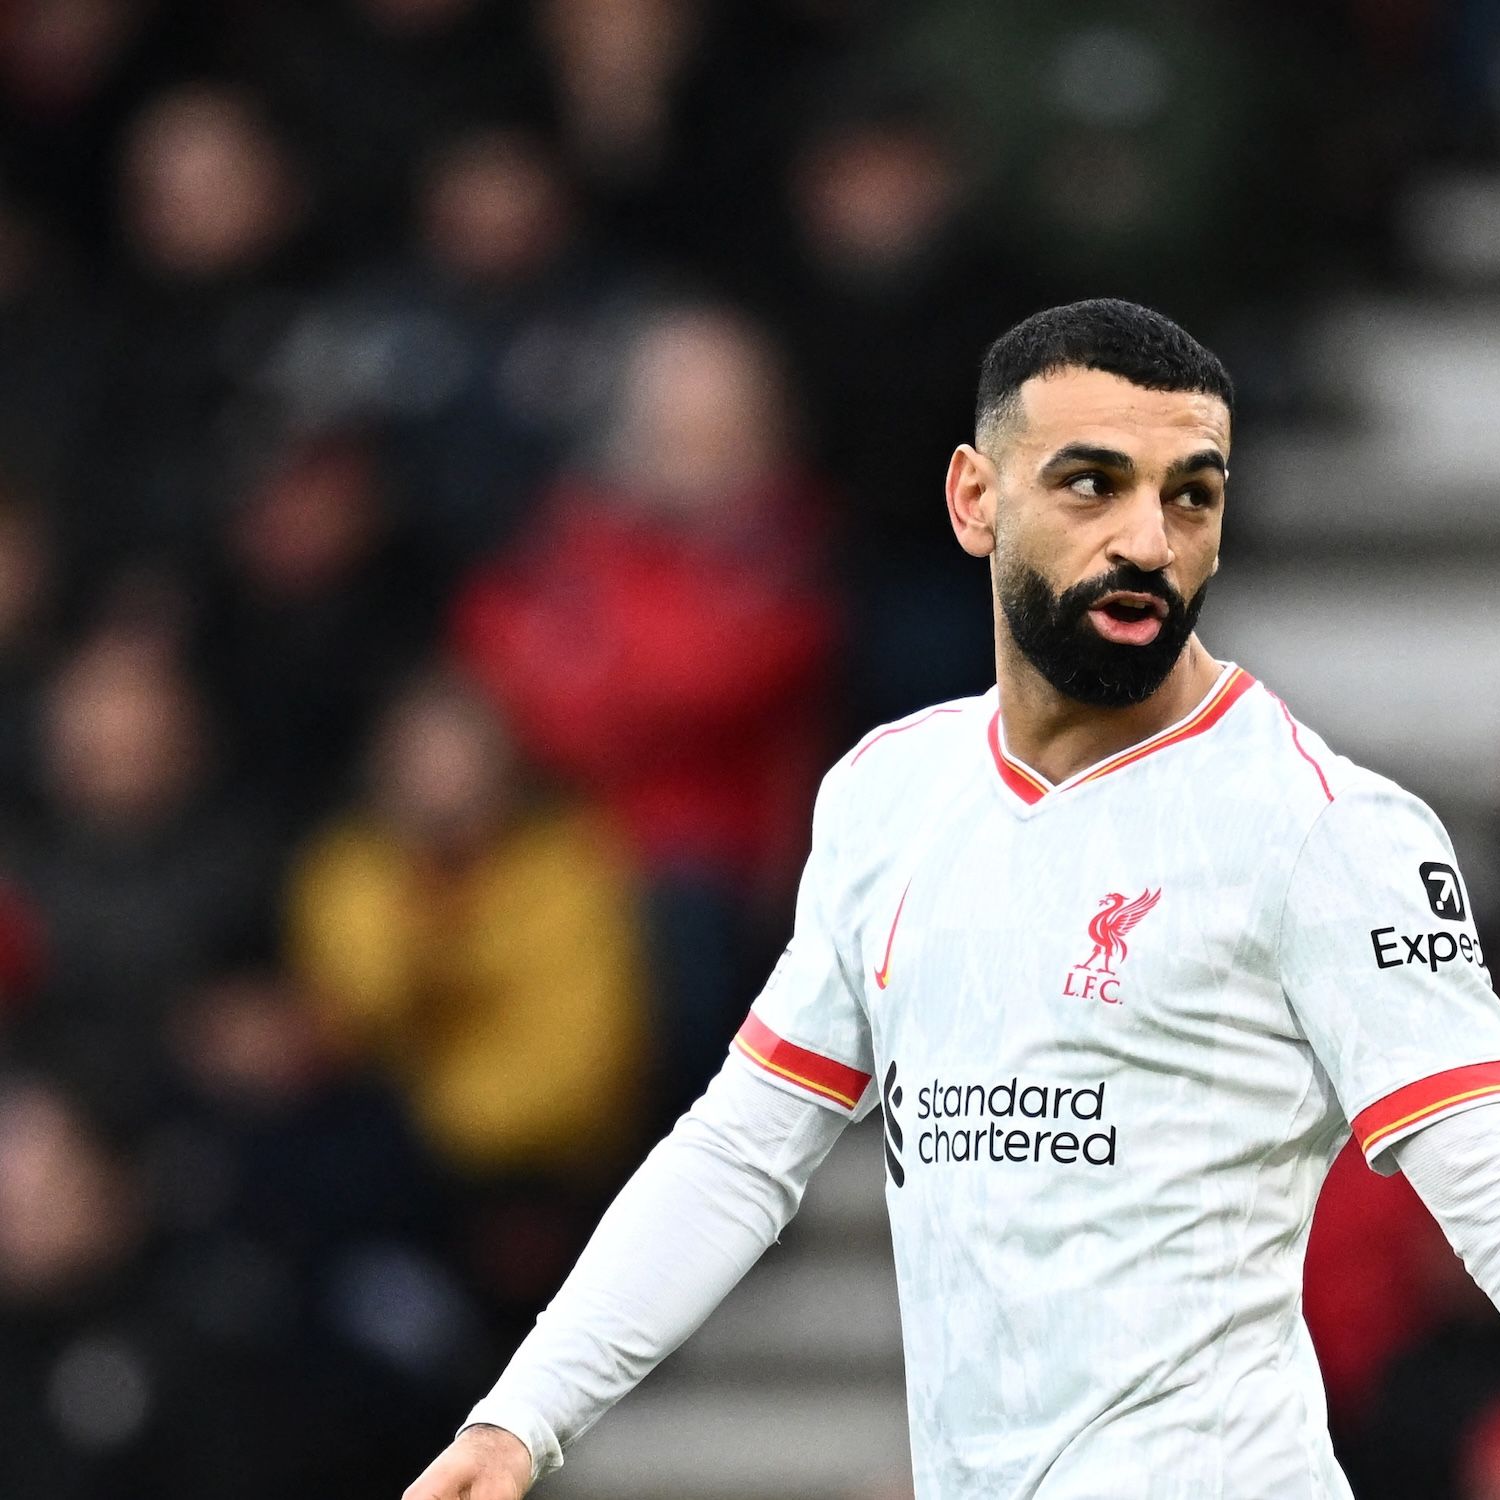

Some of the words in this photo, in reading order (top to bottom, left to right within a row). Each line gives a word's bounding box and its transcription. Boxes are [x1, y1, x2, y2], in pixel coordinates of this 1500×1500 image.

[1062, 972, 1123, 1005] L.F.C.
[918, 1077, 1105, 1120] standard
[918, 1121, 1117, 1166] chartered
